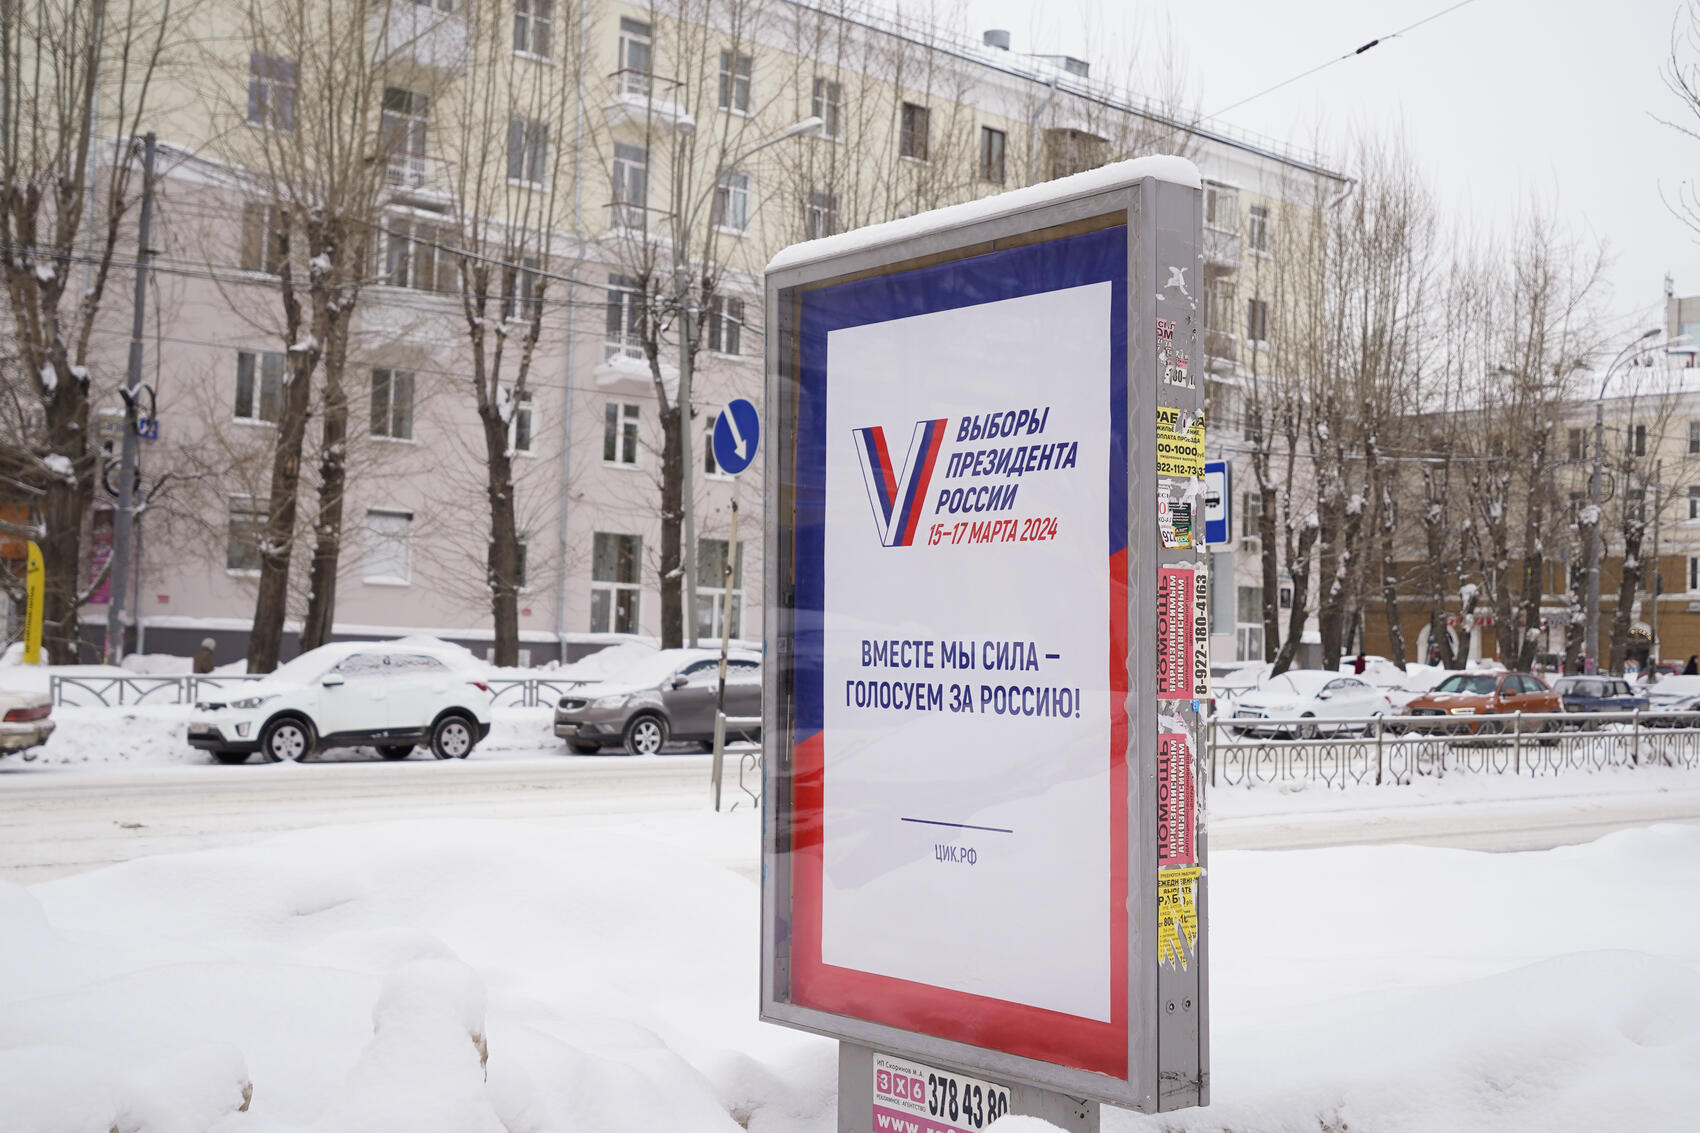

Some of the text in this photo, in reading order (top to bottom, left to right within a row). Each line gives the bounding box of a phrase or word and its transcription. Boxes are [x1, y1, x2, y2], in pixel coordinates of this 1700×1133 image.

[956, 407, 1050, 442] ВЫБОРЫ
[945, 441, 1079, 478] ПРЕЗИДЕНТА
[935, 484, 1019, 514] РОССИИ
[968, 519, 1018, 544] МАРТА
[1019, 517, 1059, 542] 2024
[1159, 576, 1169, 693] ПОМОЩЬ
[1177, 579, 1185, 688] АЛКОЗАВИСИМЫМ
[1195, 574, 1207, 695] 8-922-180-4163
[861, 640, 934, 668] ВМЕСТЕ
[941, 641, 975, 669] МЫ
[982, 641, 1039, 671] СИЛА
[846, 680, 1080, 719] ГОЛОСУЕМ ЗА РОССИЮ!
[1158, 740, 1170, 859] ПОМОЩЬ
[935, 844, 977, 866] ЦИК.РФ
[928, 1073, 959, 1122] 378
[963, 1083, 983, 1129] 43
